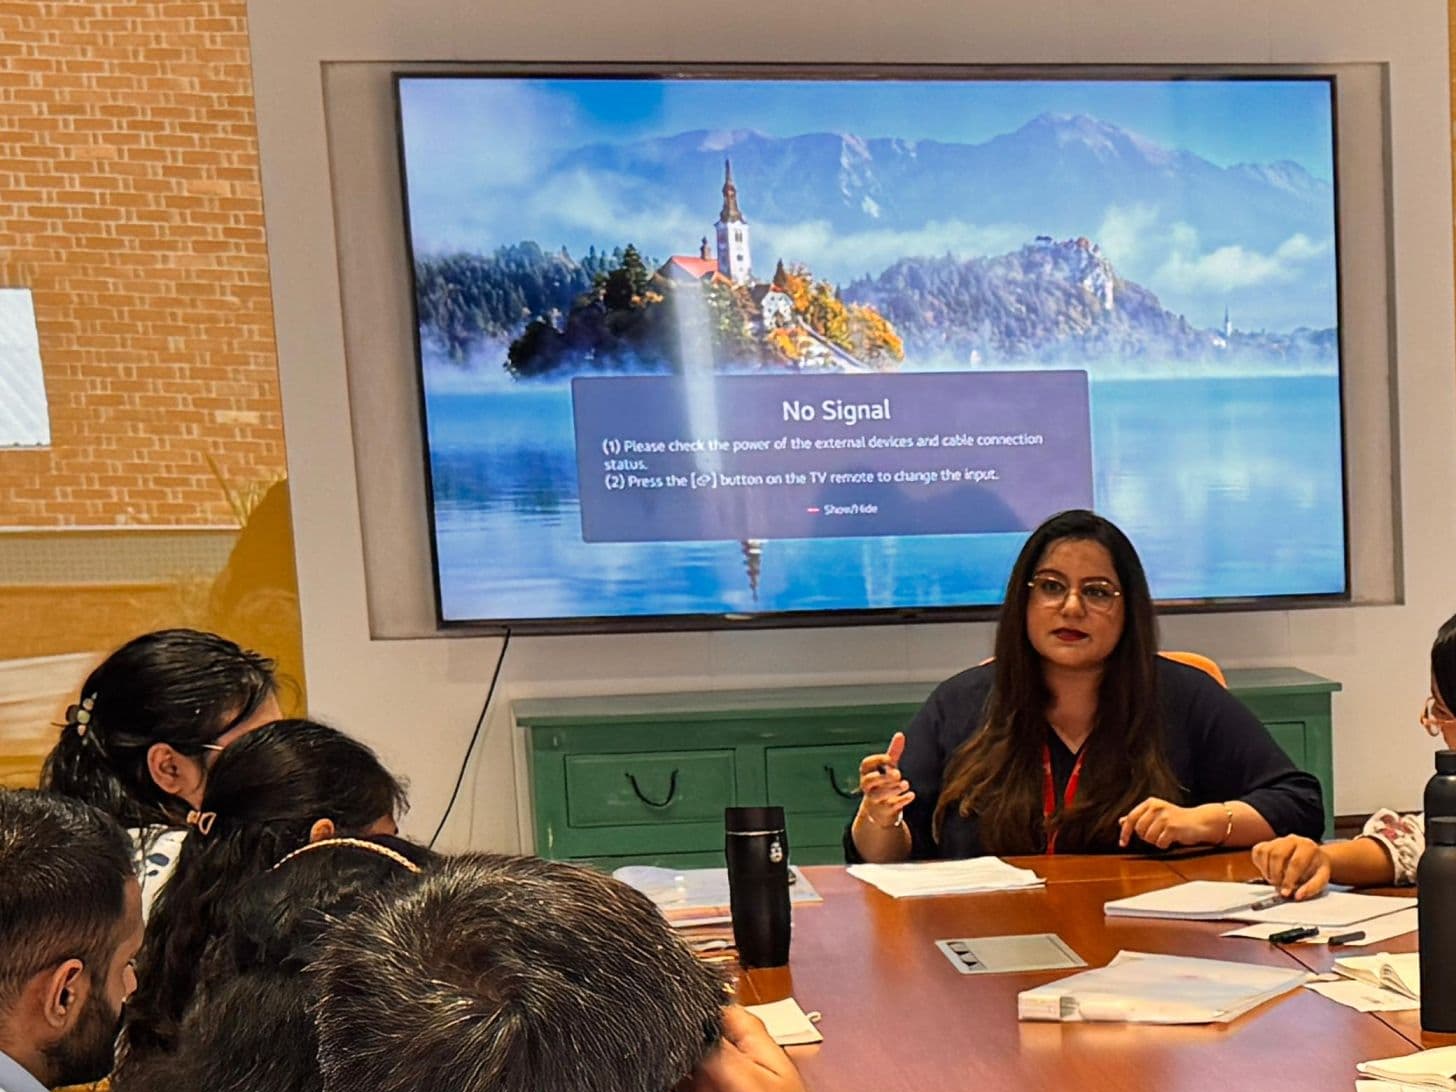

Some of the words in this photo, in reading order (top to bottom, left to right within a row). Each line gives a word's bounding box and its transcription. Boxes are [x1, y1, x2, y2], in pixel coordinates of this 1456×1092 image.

[783, 400, 815, 421] No
[821, 398, 891, 425] Signal
[602, 438, 621, 455] (1)
[624, 440, 665, 453] Please
[669, 439, 703, 452] check
[708, 438, 729, 451] the
[732, 439, 770, 453] power
[774, 436, 788, 450] of
[791, 436, 812, 450] the
[815, 435, 866, 450] external
[868, 434, 914, 449] devices
[917, 434, 939, 448] and
[942, 433, 974, 448] cable
[977, 432, 1043, 447] connection
[604, 458, 648, 471] status.
[605, 473, 625, 490] (2)
[629, 474, 664, 488] Press
[666, 473, 688, 488] the
[720, 472, 763, 487] button
[766, 475, 783, 485] on
[786, 472, 806, 485] the
[809, 471, 827, 483] TV
[830, 472, 873, 484] remote
[877, 471, 892, 483] to
[894, 469, 938, 485] change
[941, 469, 961, 482] the
[964, 467, 999, 483] input.
[823, 503, 878, 516] Show/Hide
